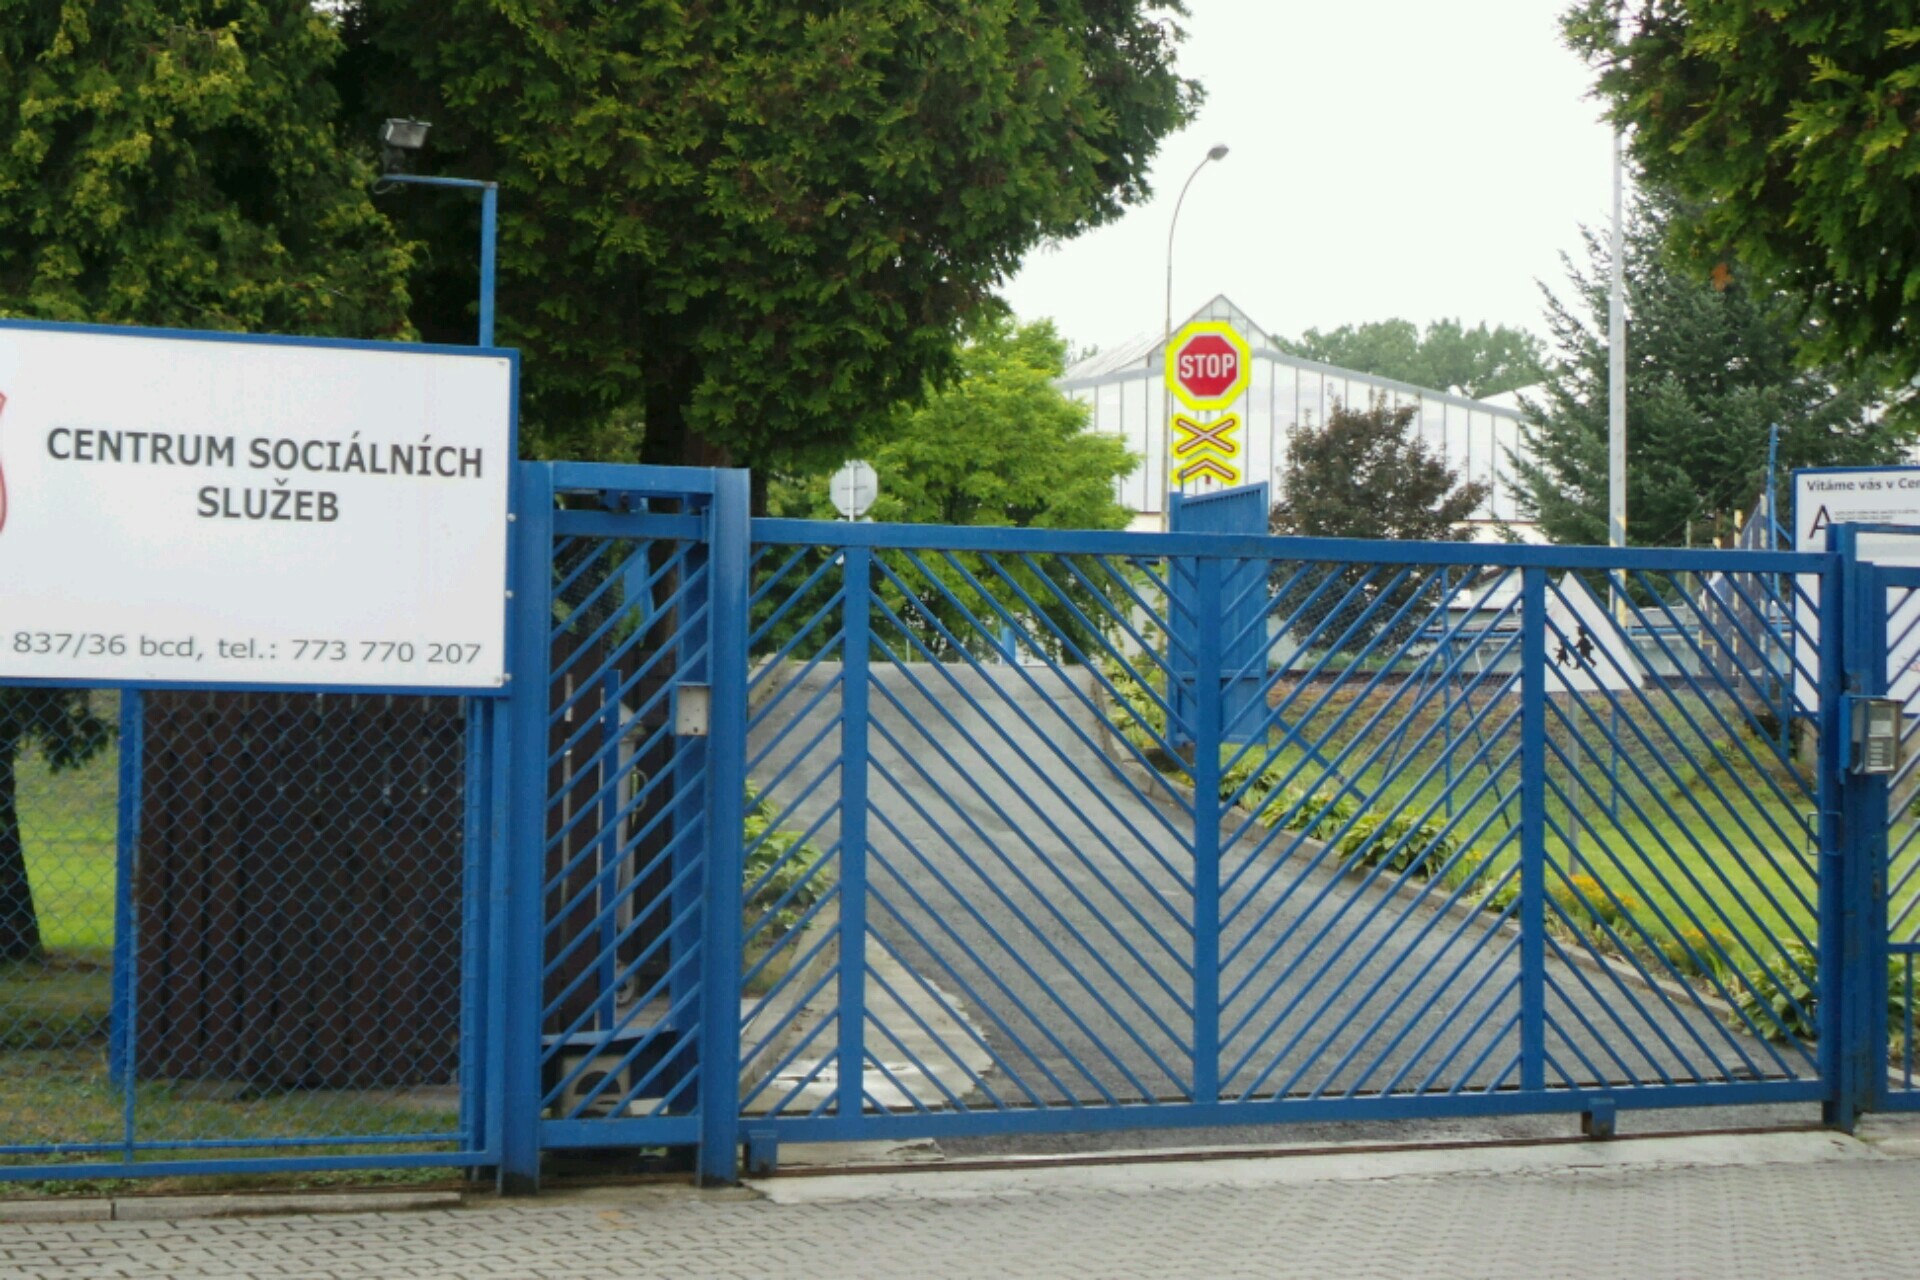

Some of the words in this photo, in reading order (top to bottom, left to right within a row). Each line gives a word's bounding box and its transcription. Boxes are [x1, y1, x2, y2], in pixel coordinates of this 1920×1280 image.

[1180, 354, 1235, 378] STOP
[46, 427, 236, 468] CENTRUM
[248, 430, 484, 478] SOCIÁLNÍCH
[197, 477, 340, 523] SLUŽEB
[1858, 478, 1882, 491] vás
[1885, 480, 1895, 489] v
[12, 631, 127, 659] 837/36
[139, 635, 205, 662] bcd,
[217, 637, 277, 660] tel.:
[292, 639, 347, 661] 773
[360, 641, 415, 663] 770
[427, 642, 482, 665] 207
